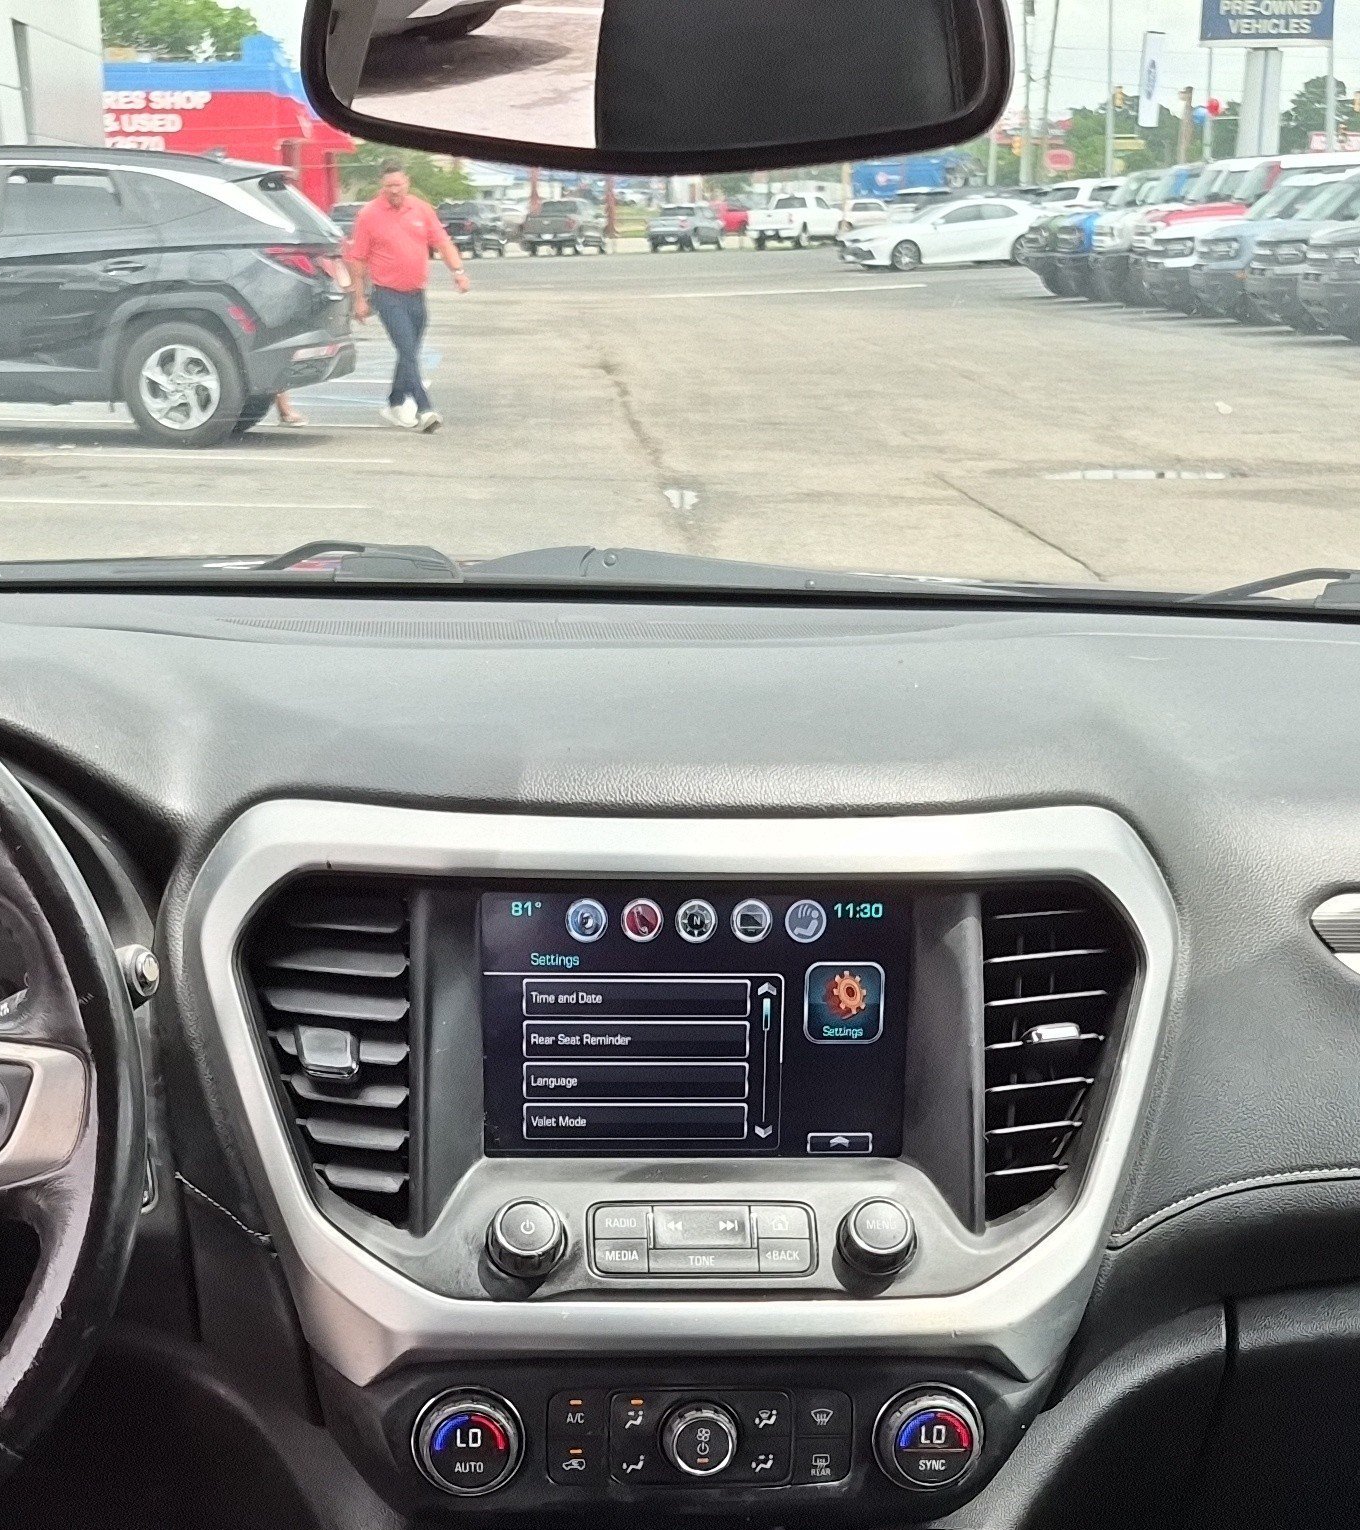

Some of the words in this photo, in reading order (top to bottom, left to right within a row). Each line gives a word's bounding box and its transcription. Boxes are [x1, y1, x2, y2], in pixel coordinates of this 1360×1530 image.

[1219, 0, 1322, 16] PRE-OWNED
[1228, 18, 1312, 34] VEHICLES
[148, 90, 212, 109] SHOP
[120, 113, 183, 132] USED
[834, 902, 883, 919] 11:30
[530, 952, 580, 968] Settings
[530, 991, 555, 1004] Time
[558, 991, 577, 1004] and
[578, 991, 603, 1004] Date
[822, 1025, 864, 1039] Settings
[530, 1033, 555, 1045] Rear
[557, 1033, 581, 1045] Seat
[582, 1033, 632, 1046] Reminder
[530, 1074, 578, 1089] Language
[530, 1115, 557, 1127] Valet
[558, 1115, 587, 1127] Mode
[605, 1218, 637, 1228] RADIO
[866, 1219, 897, 1230] MENU
[605, 1250, 639, 1261] MEDIA
[688, 1255, 715, 1266] TONE
[773, 1250, 800, 1261] BACK
[566, 1412, 585, 1424] A/C
[456, 1428, 482, 1448] LO
[920, 1425, 946, 1444] LO
[455, 1461, 484, 1473] AUTO
[810, 1467, 831, 1476] REAR
[918, 1460, 946, 1471] SYNC
